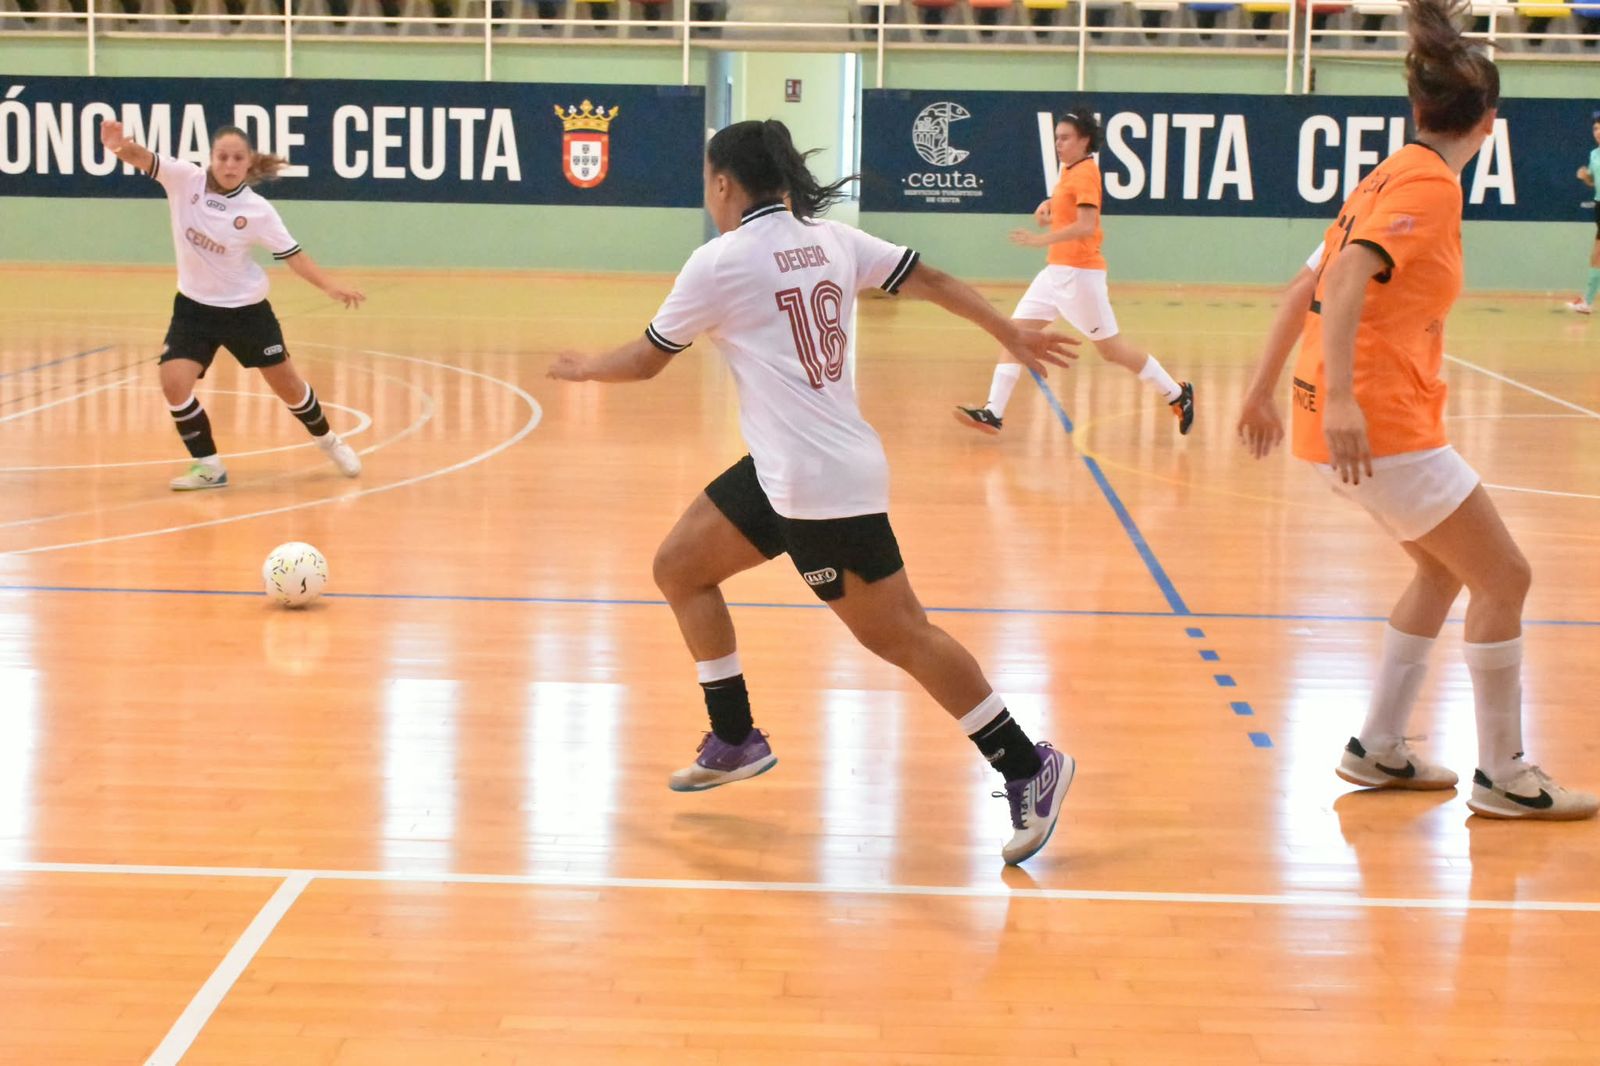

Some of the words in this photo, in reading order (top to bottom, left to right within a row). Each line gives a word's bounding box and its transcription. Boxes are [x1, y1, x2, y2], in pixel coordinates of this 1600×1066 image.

[332, 104, 522, 182] CEUTA
[907, 170, 978, 188] ceuta
[1037, 111, 1254, 200] VSITA
[1297, 114, 1517, 205] CEA
[775, 280, 847, 389] 18
